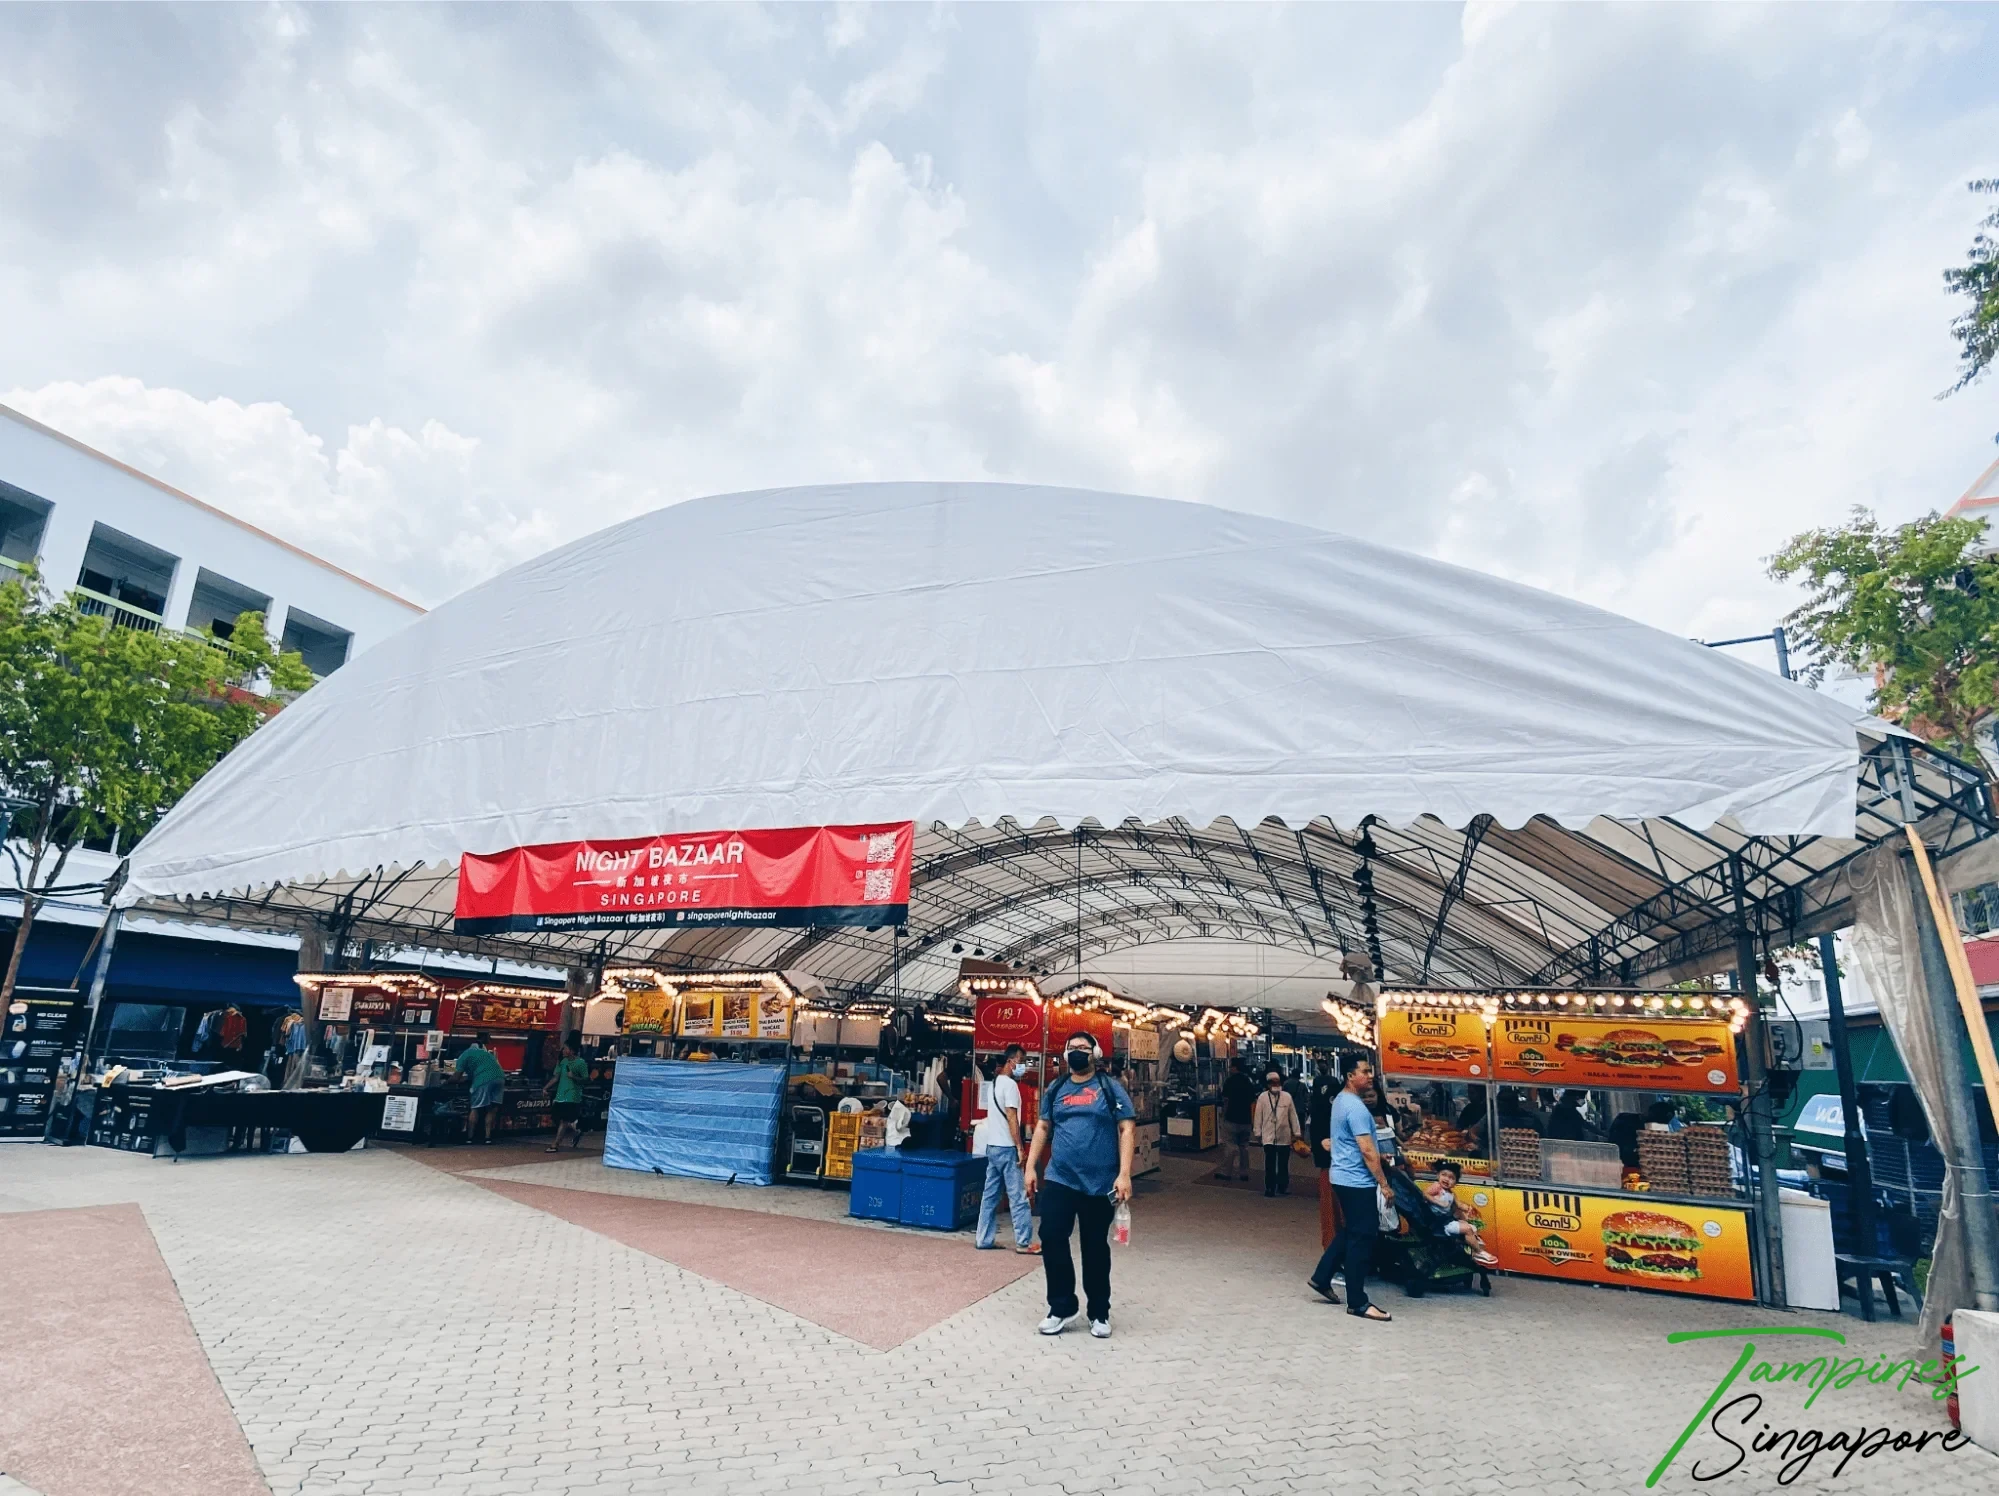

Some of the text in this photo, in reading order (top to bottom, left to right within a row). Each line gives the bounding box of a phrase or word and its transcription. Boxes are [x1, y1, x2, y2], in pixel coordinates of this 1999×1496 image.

[576, 841, 745, 873] NIGHT BAZAAR
[600, 889, 702, 906] SINGAPORE
[1417, 1024, 1448, 1035] Ramly
[1514, 1033, 1543, 1042] Ramly
[1534, 1214, 1571, 1229] Ramly
[1543, 1239, 1567, 1248] 100%
[1524, 1246, 1587, 1259] MUSLIM OWNER
